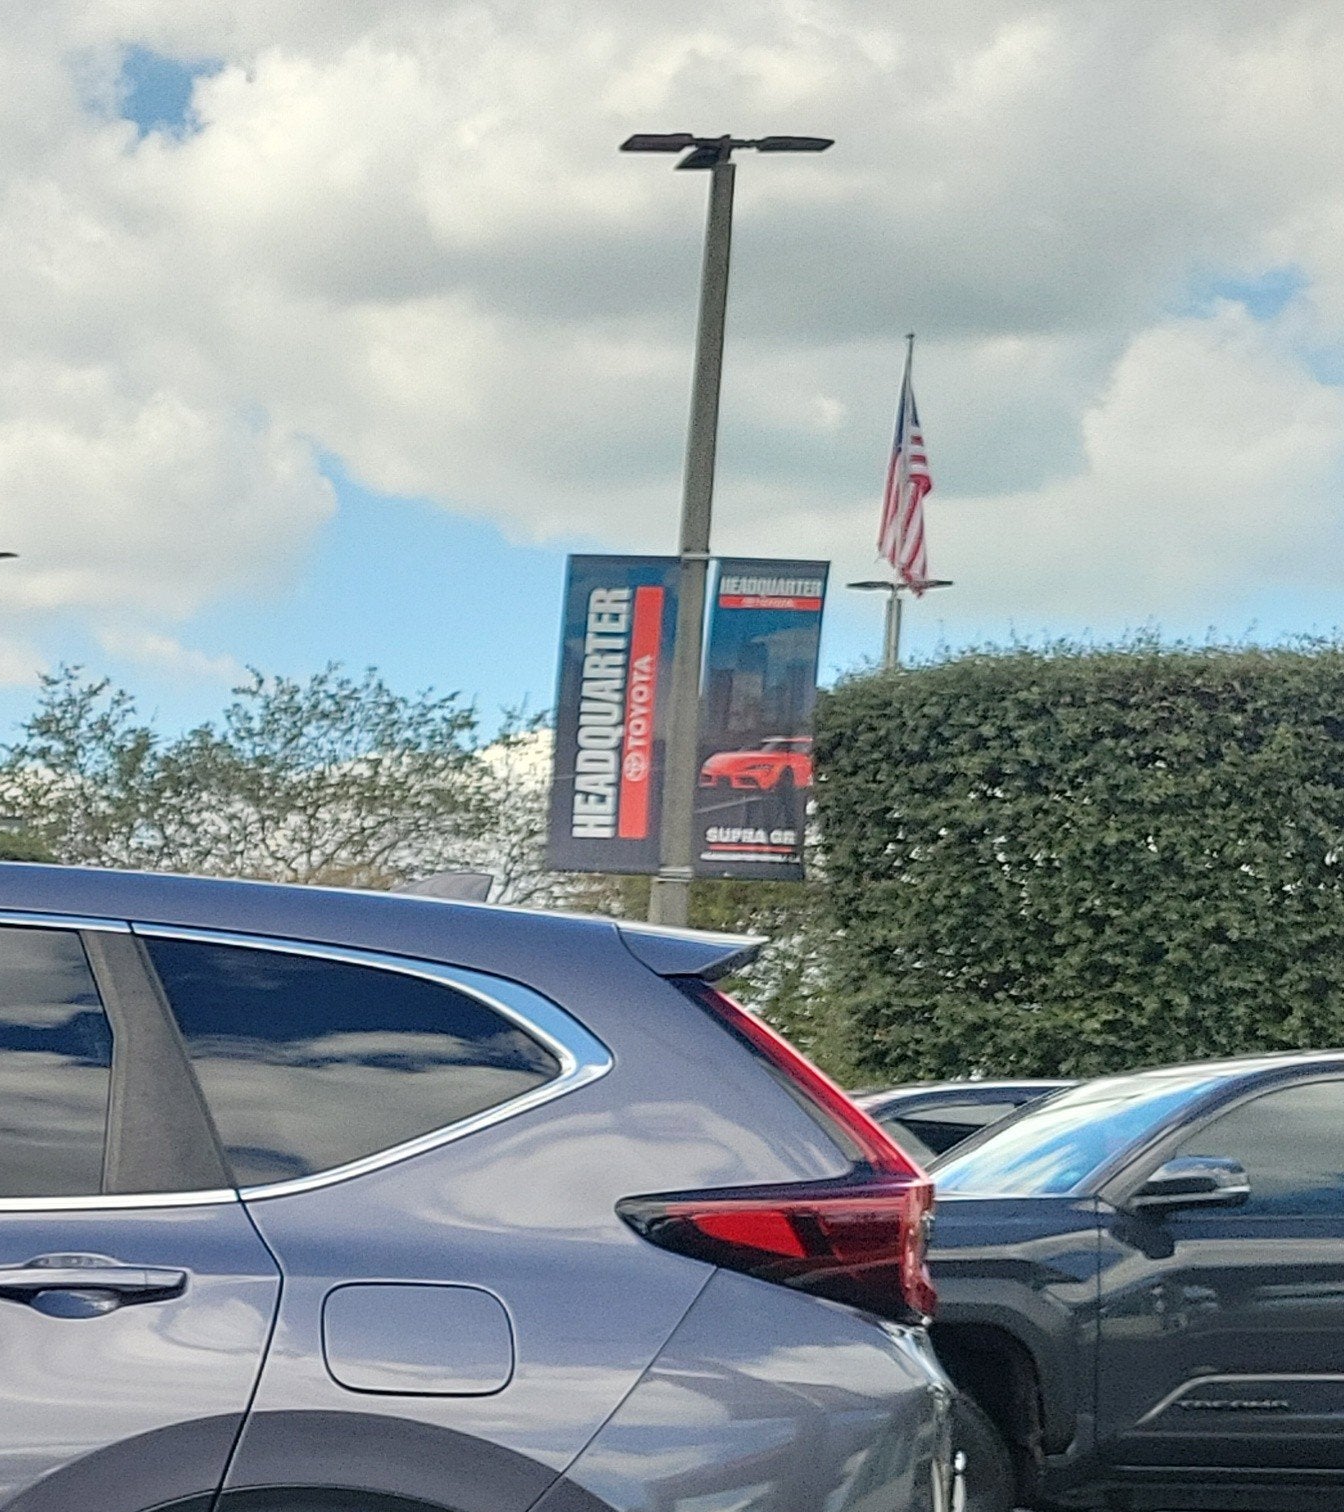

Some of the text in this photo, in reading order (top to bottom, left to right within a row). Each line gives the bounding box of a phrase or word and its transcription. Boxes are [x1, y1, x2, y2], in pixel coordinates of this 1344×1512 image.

[719, 576, 823, 597] HEADQUARTER
[572, 586, 631, 839] HEADQUARTER
[627, 655, 655, 747] TOYOTA
[706, 827, 768, 844] SUPRA
